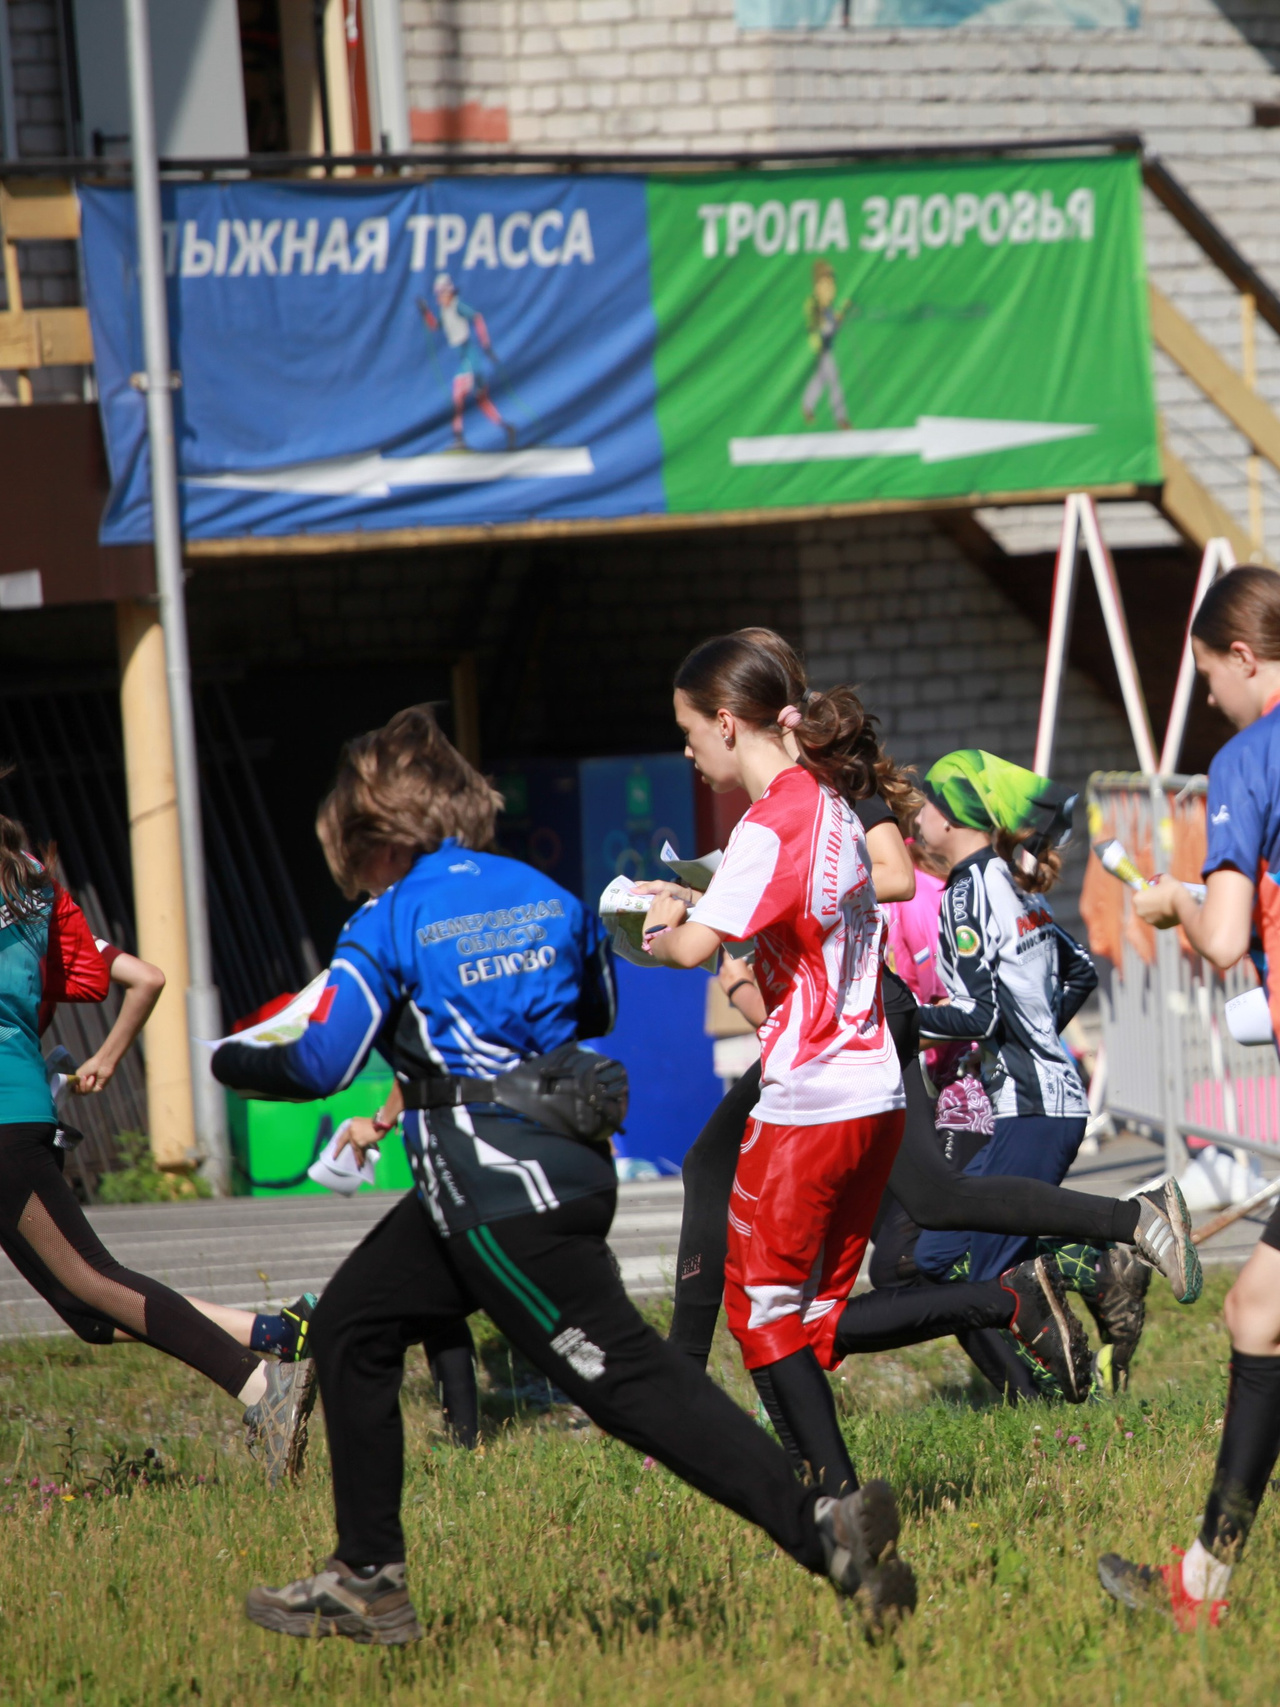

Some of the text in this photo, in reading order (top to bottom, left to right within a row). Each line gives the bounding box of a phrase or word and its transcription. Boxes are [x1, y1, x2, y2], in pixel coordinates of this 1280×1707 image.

[407, 209, 596, 272] ТРАССА
[697, 187, 1096, 260] ТРОПА ЗДОРОВЬЯ
[416, 898, 565, 947] КЕМЕРОВСКАЯ
[456, 922, 548, 956] ОБЛАСТЬ
[458, 945, 557, 988] БЕЛОВО
